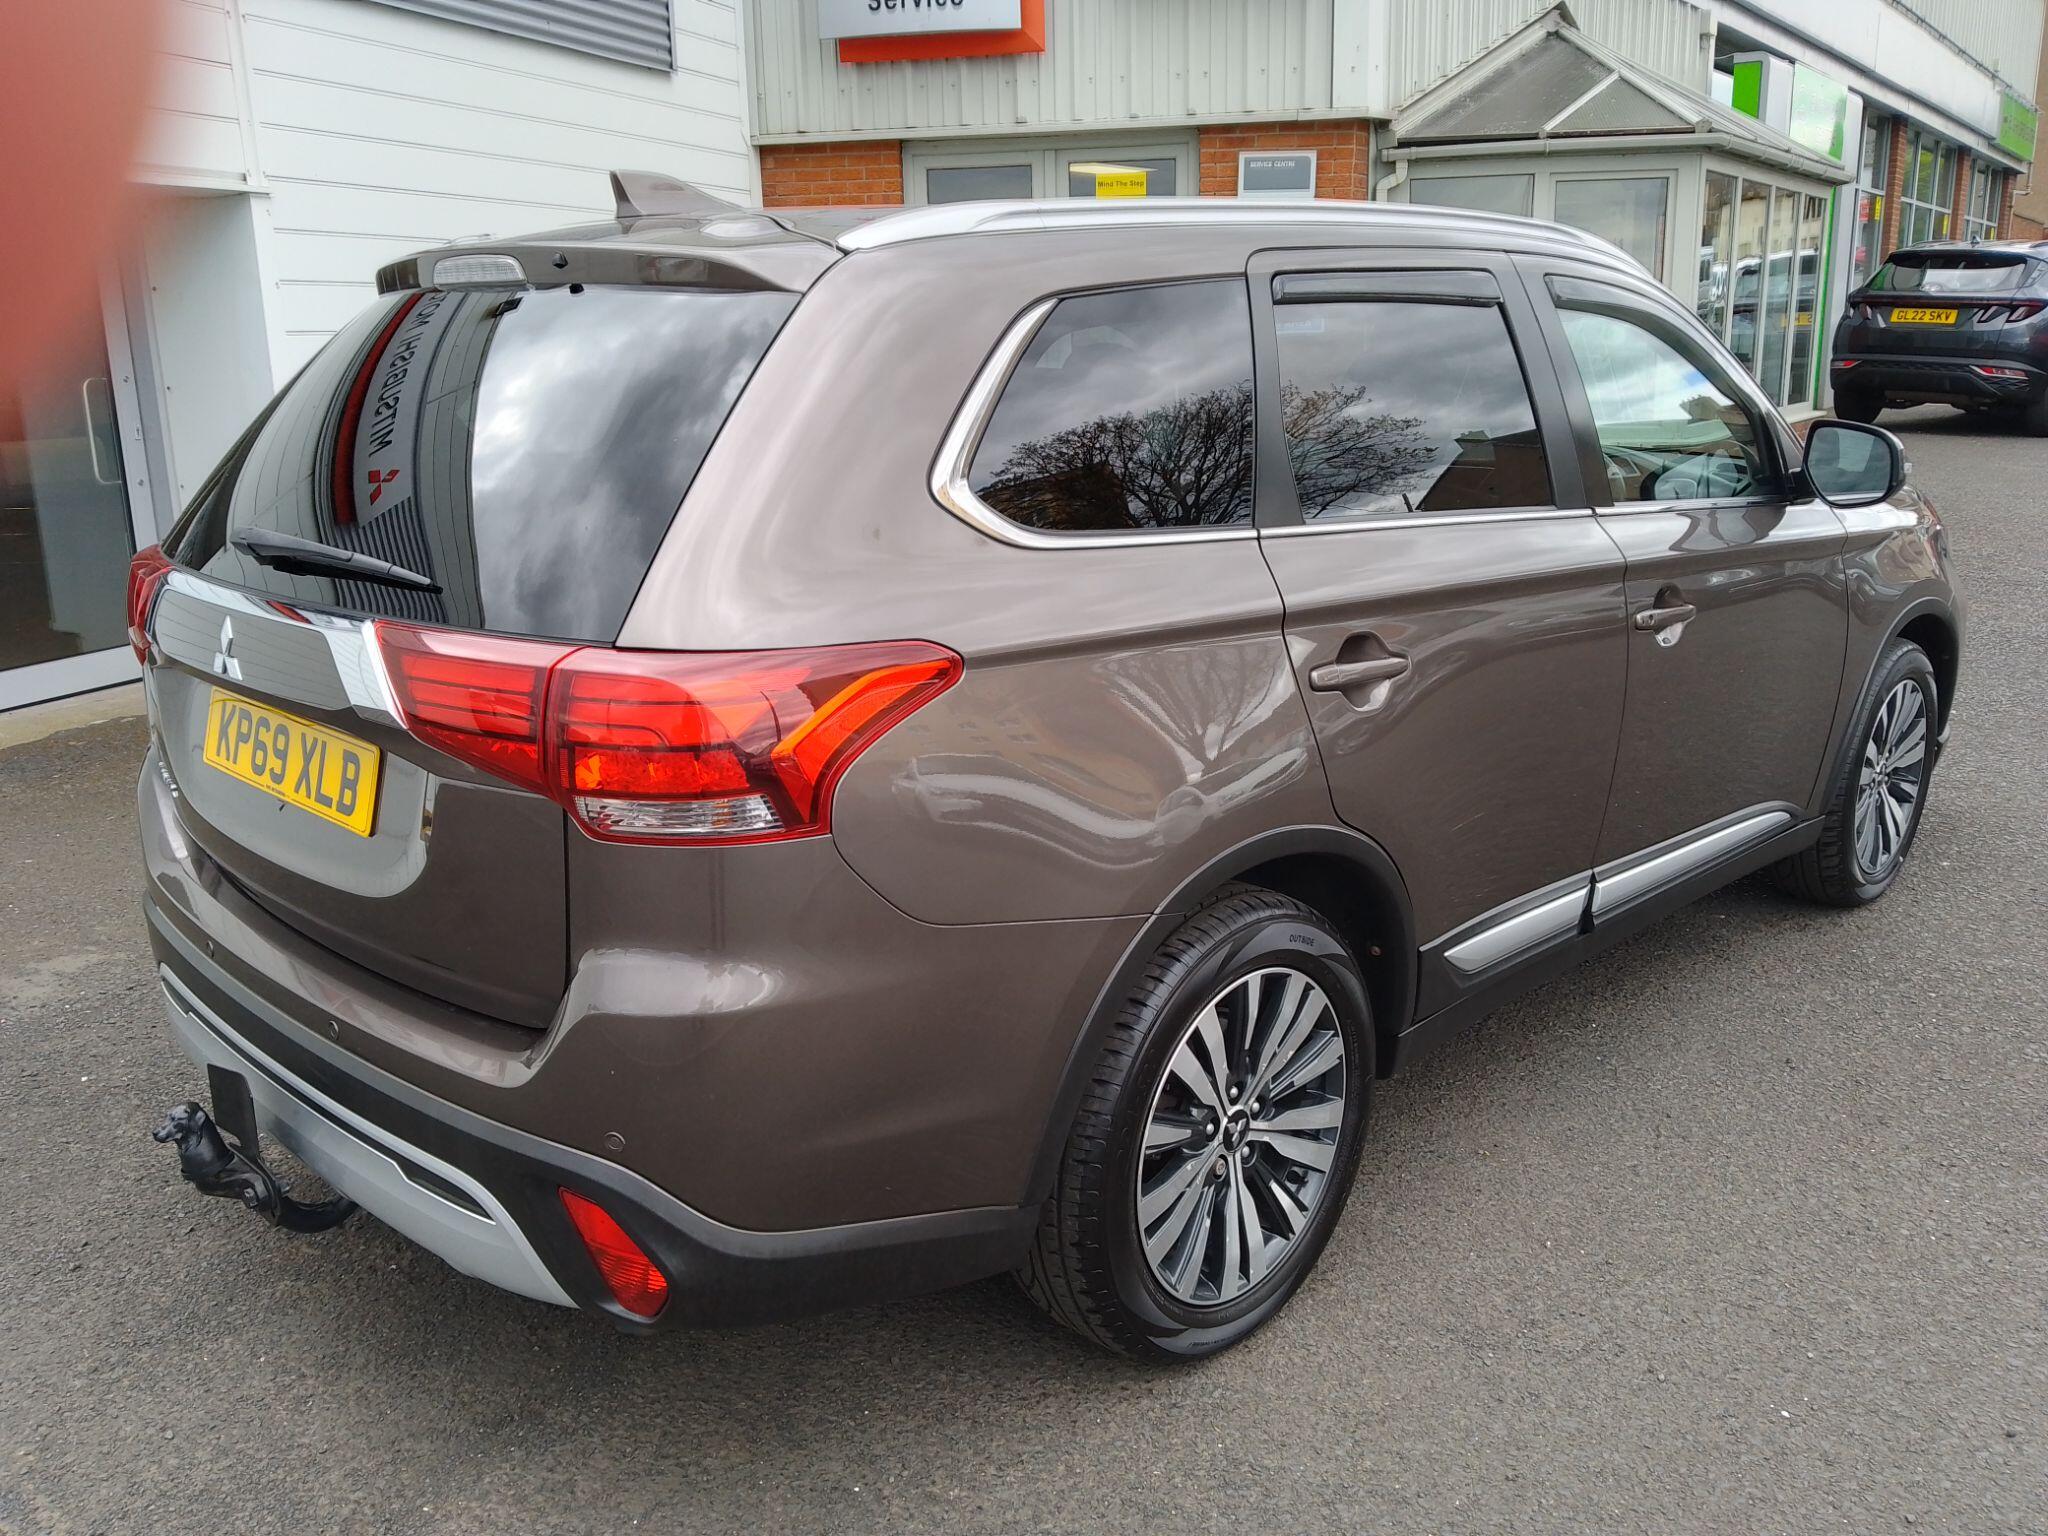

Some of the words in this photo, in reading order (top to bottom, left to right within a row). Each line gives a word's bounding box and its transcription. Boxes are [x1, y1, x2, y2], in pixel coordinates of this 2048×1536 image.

[1129, 180, 1145, 188] Step
[1896, 310, 1927, 321] GL22
[1929, 310, 1953, 321] SKV
[216, 702, 290, 786] KP69
[294, 732, 361, 817] XLB
